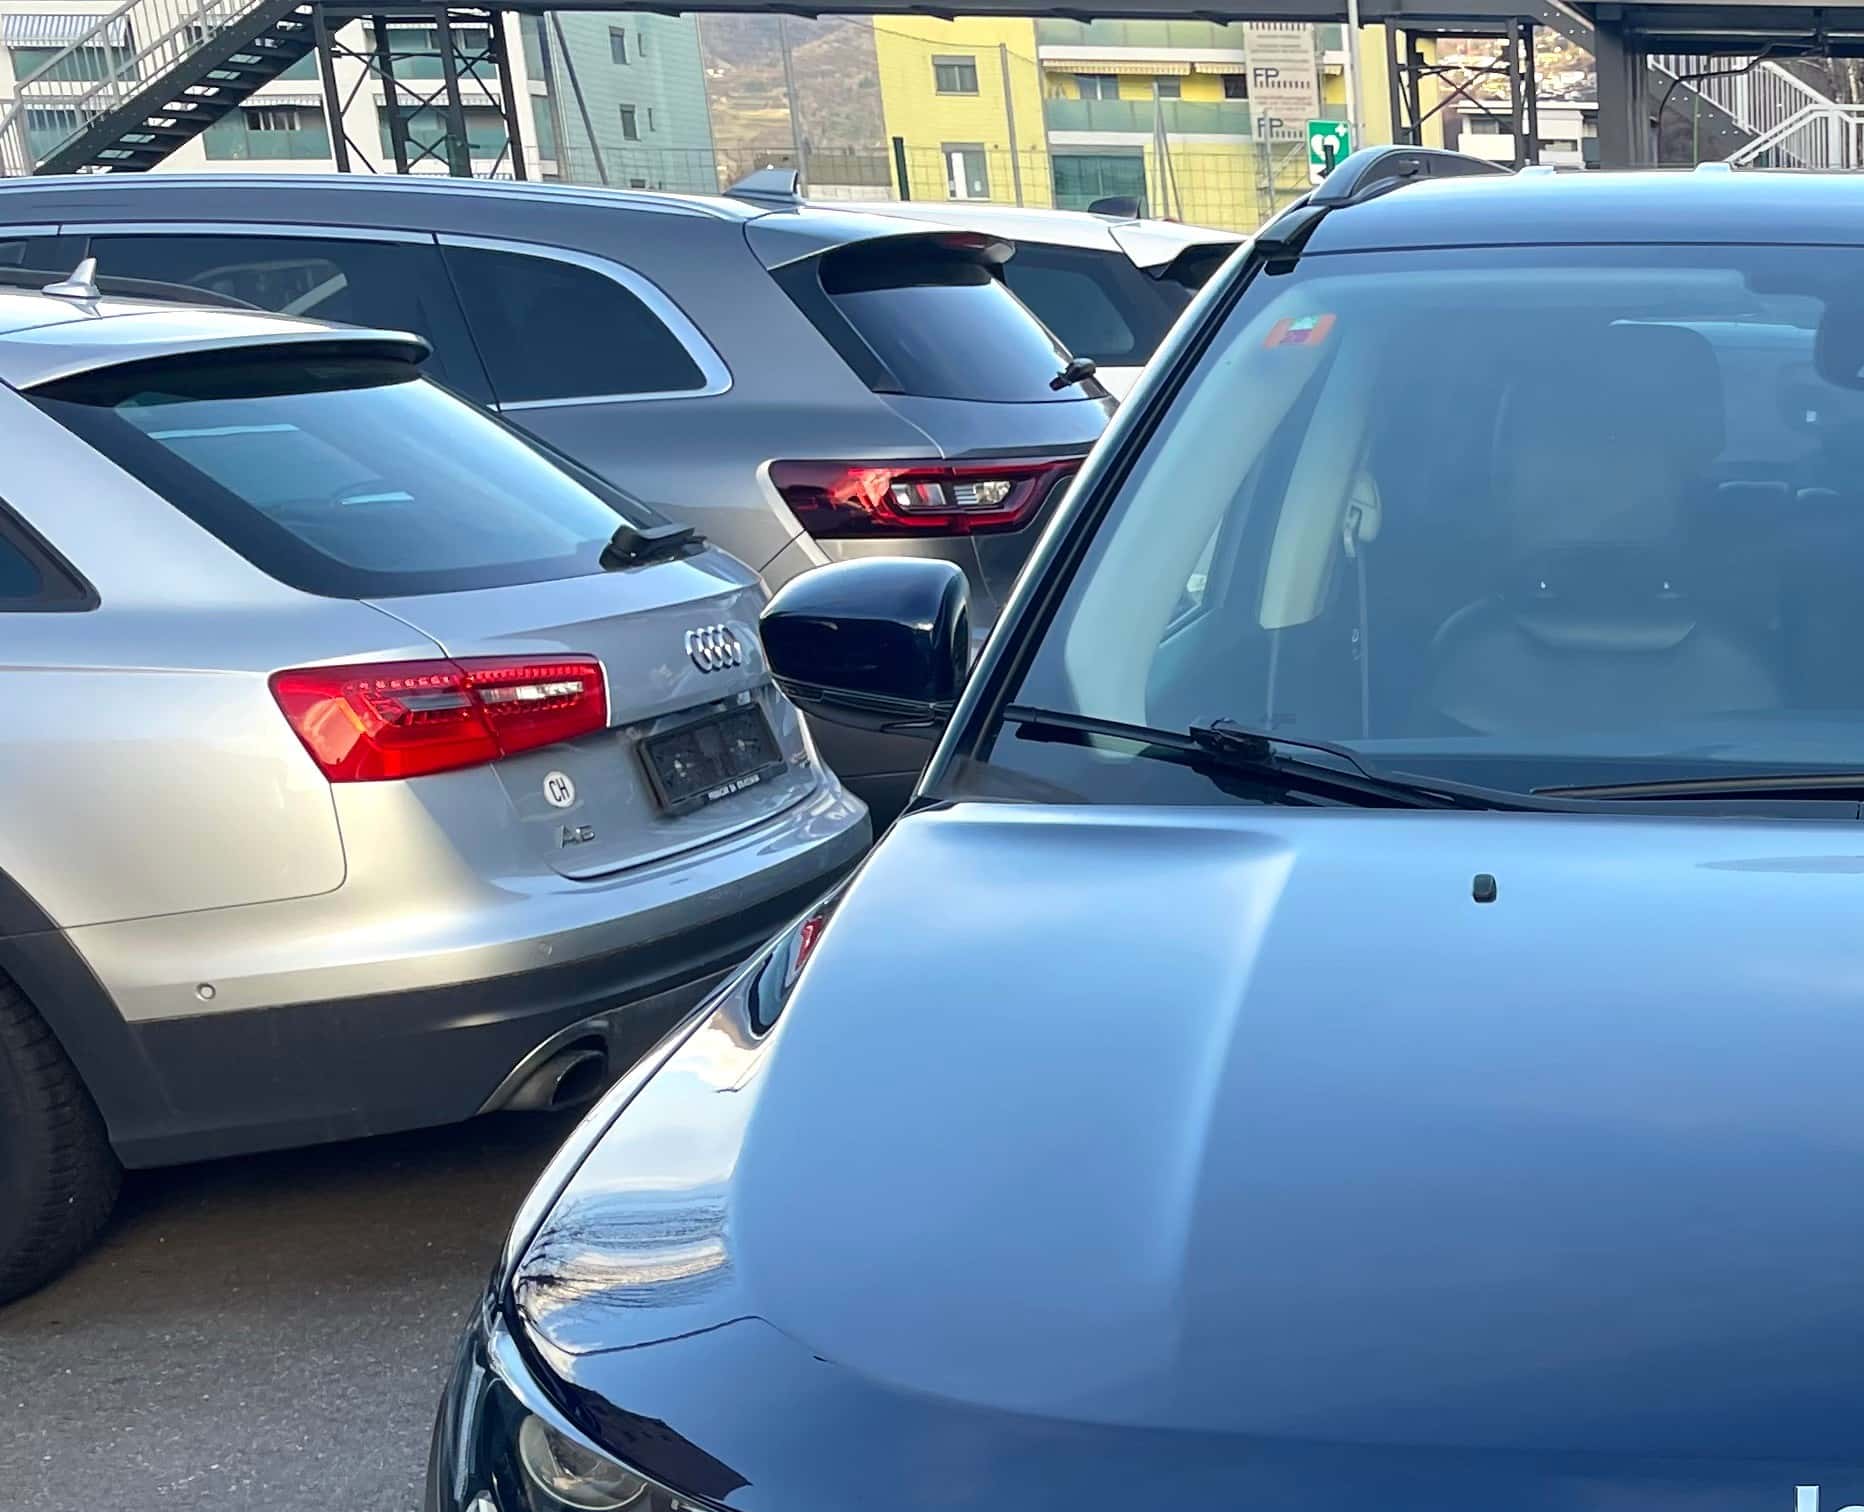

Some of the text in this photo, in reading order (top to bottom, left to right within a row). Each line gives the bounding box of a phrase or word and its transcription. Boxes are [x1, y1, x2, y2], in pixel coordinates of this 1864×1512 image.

[1253, 67, 1279, 88] FP
[549, 777, 570, 802] CH
[560, 825, 595, 848] A6
